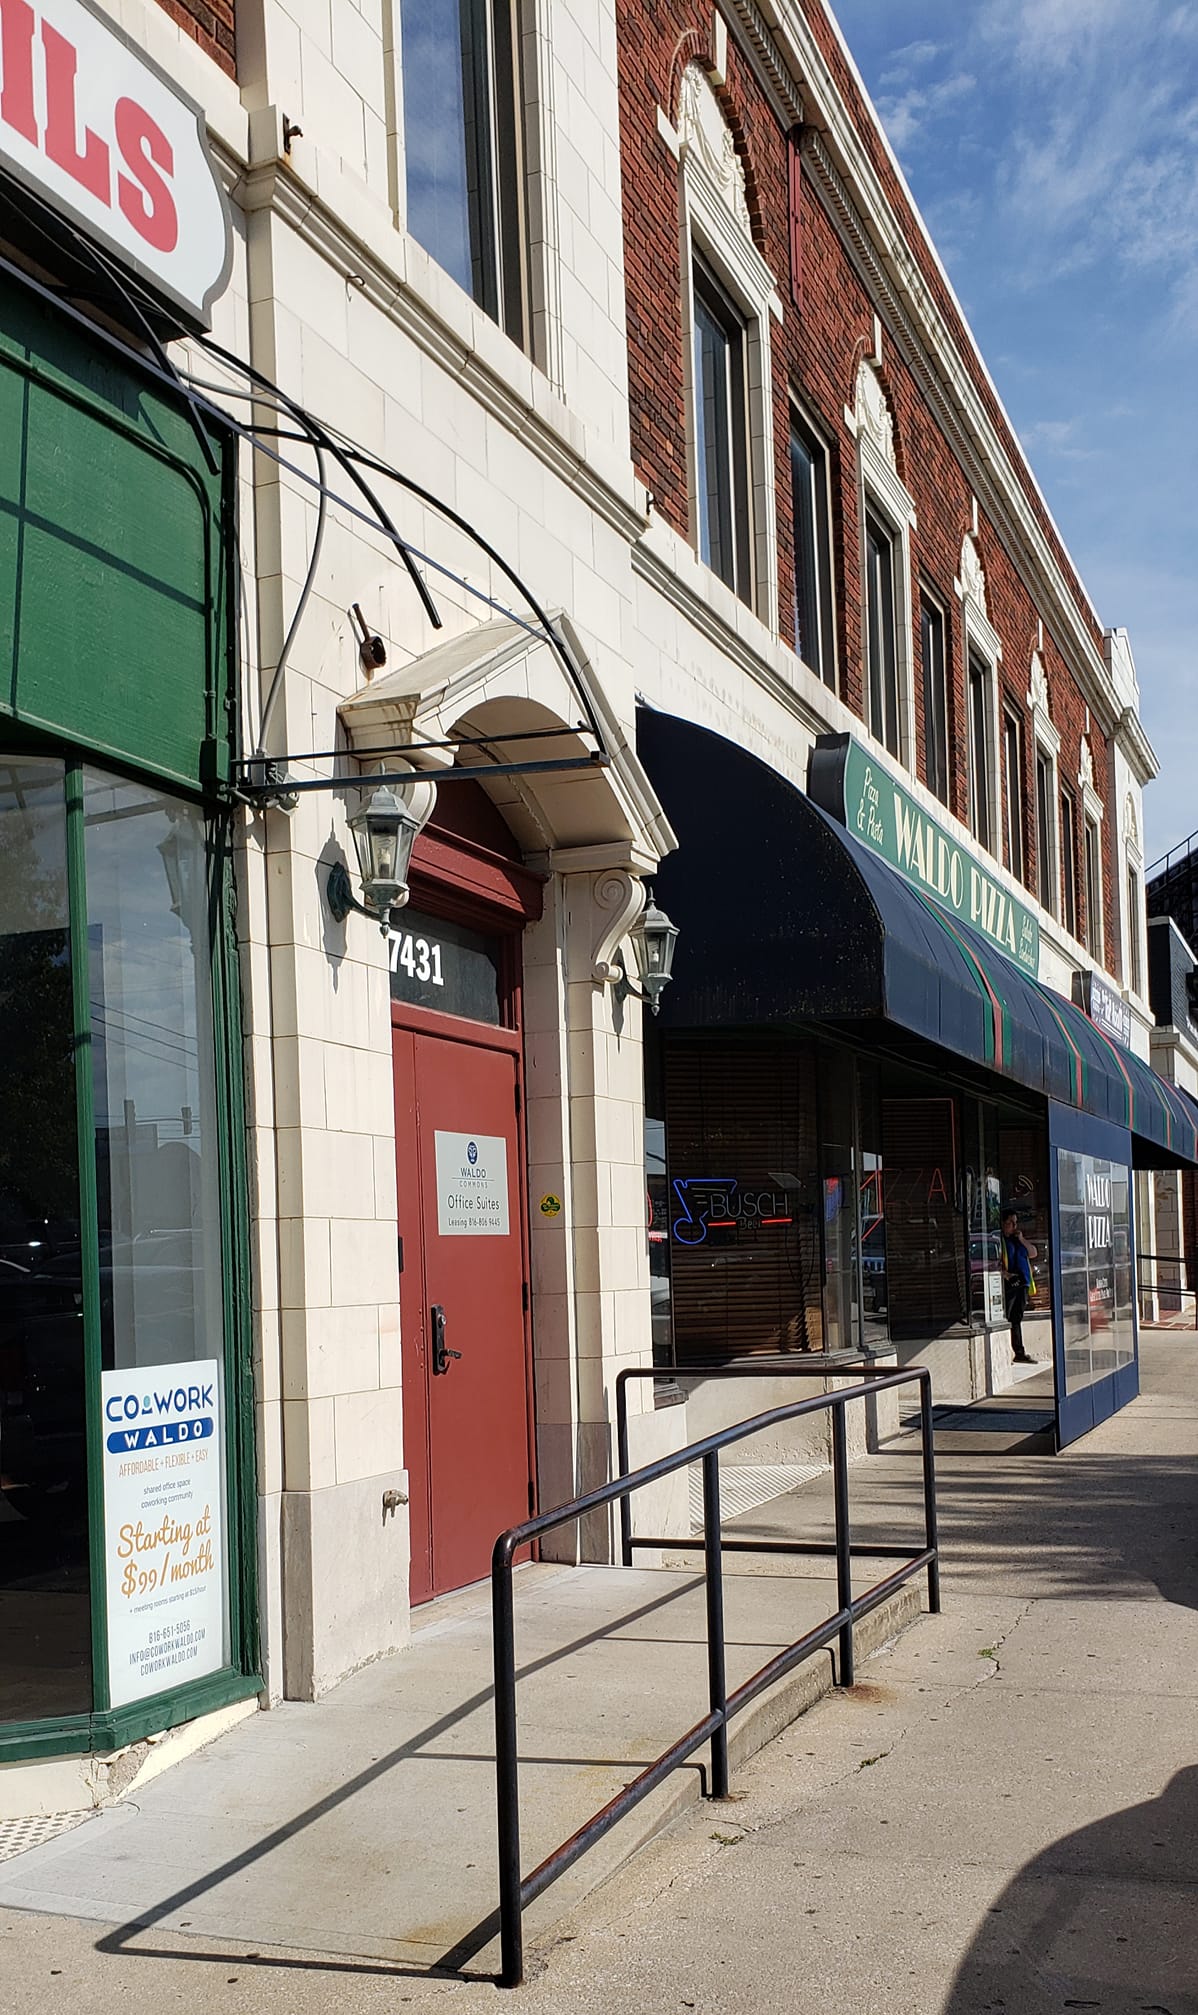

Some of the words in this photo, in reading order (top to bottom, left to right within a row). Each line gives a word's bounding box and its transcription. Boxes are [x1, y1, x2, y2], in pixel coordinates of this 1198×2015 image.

[862, 767, 879, 808] Pizza
[857, 798, 866, 831] &
[866, 805, 883, 846] Pasta
[893, 792, 964, 910] WALDO
[970, 866, 1017, 954] PIZZA
[388, 928, 444, 986] 7431
[459, 1180, 488, 1189] COMMONS
[460, 1167, 487, 1178] WALDO
[447, 1194, 473, 1209] Office
[476, 1195, 500, 1210] Suites
[710, 1192, 789, 1218] BUSCH
[448, 1217, 468, 1229] Leasing
[1088, 1215, 1113, 1249] PIZZA
[124, 1420, 203, 1449] WALDO
[119, 1457, 160, 1478] AFFORDABLE
[165, 1451, 191, 1468] FLEXIBLE
[195, 1448, 208, 1463] EASY
[140, 1495, 167, 1509] coworking
[168, 1490, 193, 1503] community
[143, 1484, 162, 1495] shared
[162, 1481, 176, 1491] office
[177, 1478, 191, 1488] space
[117, 1514, 194, 1558] Starting
[195, 1504, 211, 1535] at
[129, 1627, 206, 1665] INFO@COWORKWALDO.COM
[140, 1645, 198, 1676] COWORKWALDO.COM
